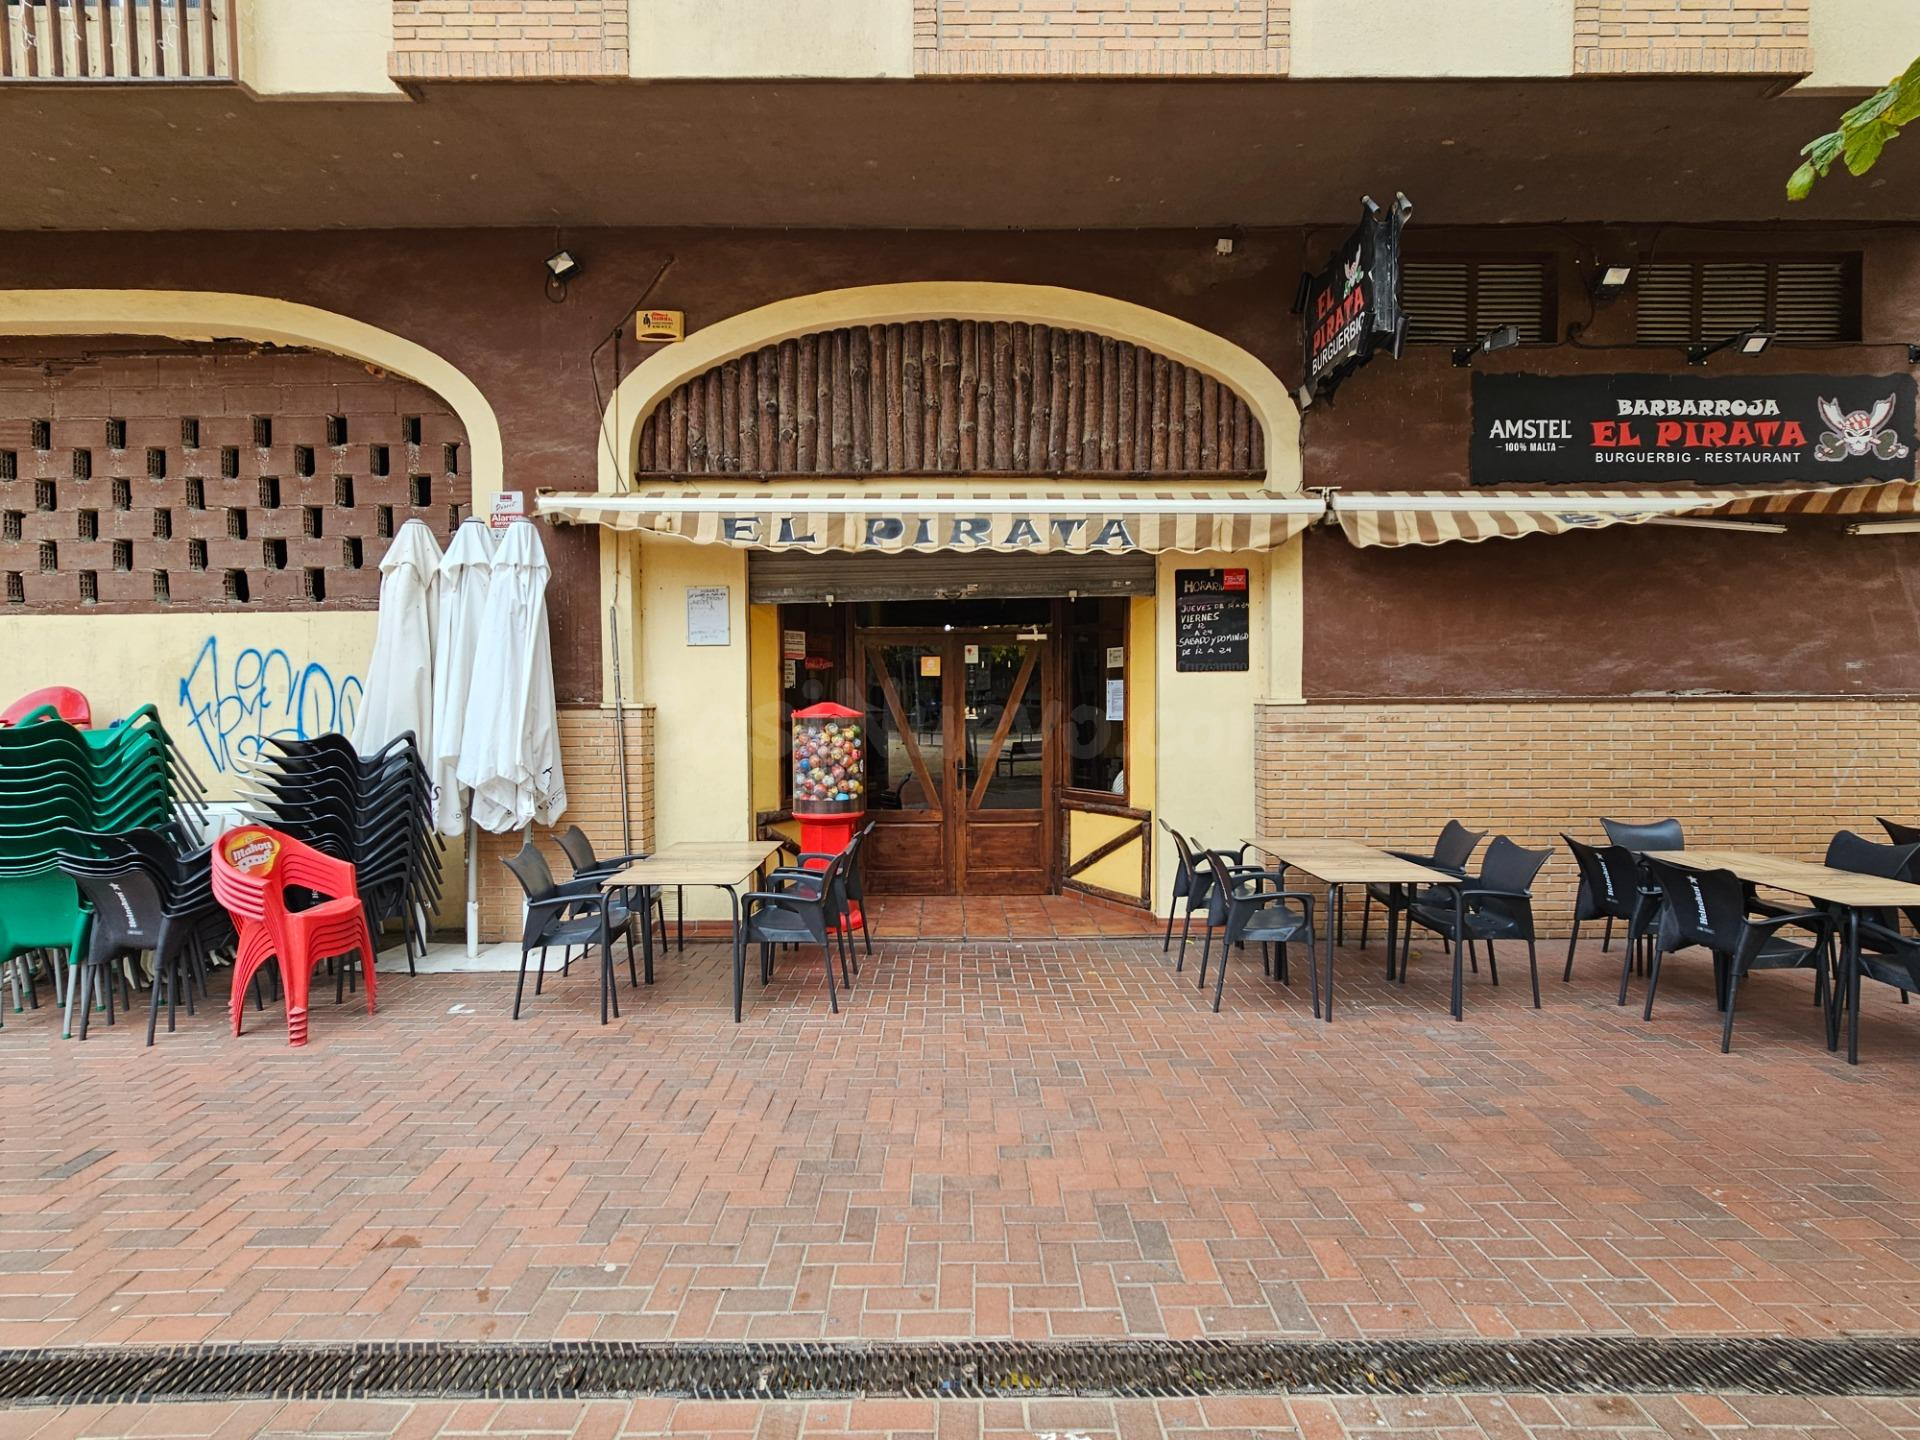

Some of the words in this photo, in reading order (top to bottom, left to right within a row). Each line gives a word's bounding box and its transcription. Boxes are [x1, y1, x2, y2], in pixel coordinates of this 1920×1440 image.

[1316, 284, 1335, 321] EL
[1312, 282, 1366, 357] PIRATA
[1616, 399, 1781, 417] BARBARROJA
[1489, 419, 1573, 440] AMSTEL
[1590, 421, 1641, 447] EL
[1656, 420, 1808, 448] PIRATA
[1505, 442, 1527, 452] 100%
[1530, 442, 1556, 452] MALTA
[1595, 452, 1691, 464] BURGUERBIG
[1704, 452, 1801, 463] RESTAURANT
[722, 516, 817, 543] EL
[863, 517, 1136, 547] PIRATA
[1181, 604, 1212, 613] JUEVES
[1181, 612, 1220, 624] VIERNES
[1216, 632, 1249, 644] DOMINGO
[1182, 648, 1192, 657] DE
[232, 841, 273, 861] Mahou
